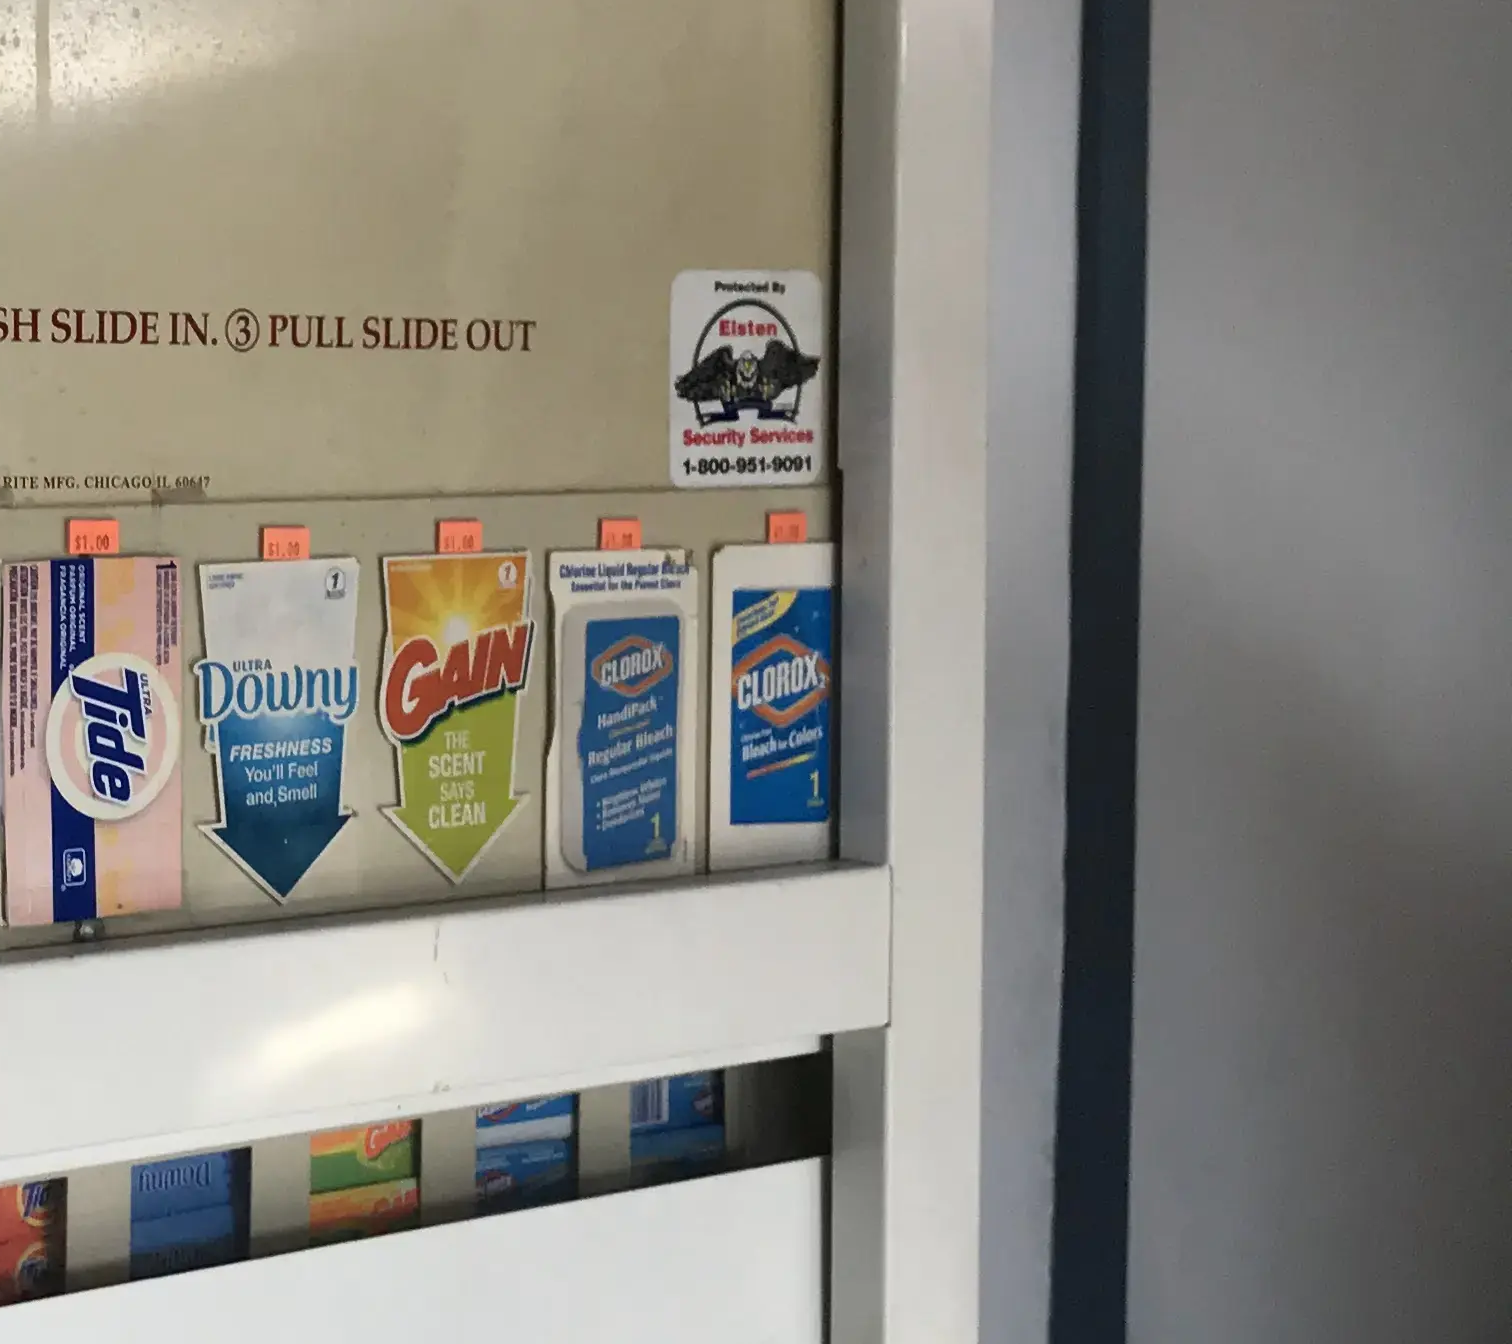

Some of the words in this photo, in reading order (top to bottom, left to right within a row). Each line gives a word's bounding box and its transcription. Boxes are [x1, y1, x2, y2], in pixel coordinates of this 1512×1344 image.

[714, 281, 769, 293] Protected
[772, 282, 786, 295] By
[50, 307, 160, 346] SLIDE
[168, 311, 219, 347] IN.
[268, 314, 354, 350] PULL
[362, 316, 459, 351] SLIDE
[466, 319, 538, 352] OUT
[683, 427, 745, 448] Security
[749, 426, 814, 444] Services
[682, 455, 813, 475] 1-800-951-9091
[3, 475, 39, 489] RITE
[84, 476, 153, 489] CHICAGO
[156, 476, 171, 489] IL
[74, 534, 110, 551] $1.00
[78, 564, 86, 611] ORIGINAL
[332, 572, 340, 590] 1
[69, 605, 77, 653] ORIGINAL
[78, 612, 87, 644] SCENT
[59, 622, 68, 671] ORIGINAL
[232, 659, 272, 673] ULTRA
[385, 623, 534, 736] GAIN
[599, 644, 665, 689] CLOROX
[139, 672, 154, 718] ULTRA
[198, 661, 358, 720] Downy
[69, 666, 149, 805] Tide
[443, 730, 471, 751] THE
[588, 738, 633, 768] Regular
[635, 722, 674, 750] Bleach
[742, 737, 777, 762] Bleach
[788, 724, 823, 749] Colors
[229, 737, 333, 763] FRESHNESS
[244, 765, 284, 783] You'll
[288, 760, 319, 779] Feel
[427, 752, 487, 779] SCENT
[278, 782, 318, 804] Smell
[440, 780, 475, 802] SAYS
[809, 768, 820, 798] 1
[427, 802, 487, 830] CLEAN
[649, 811, 661, 839] 1
[138, 1160, 212, 1193] Downy
